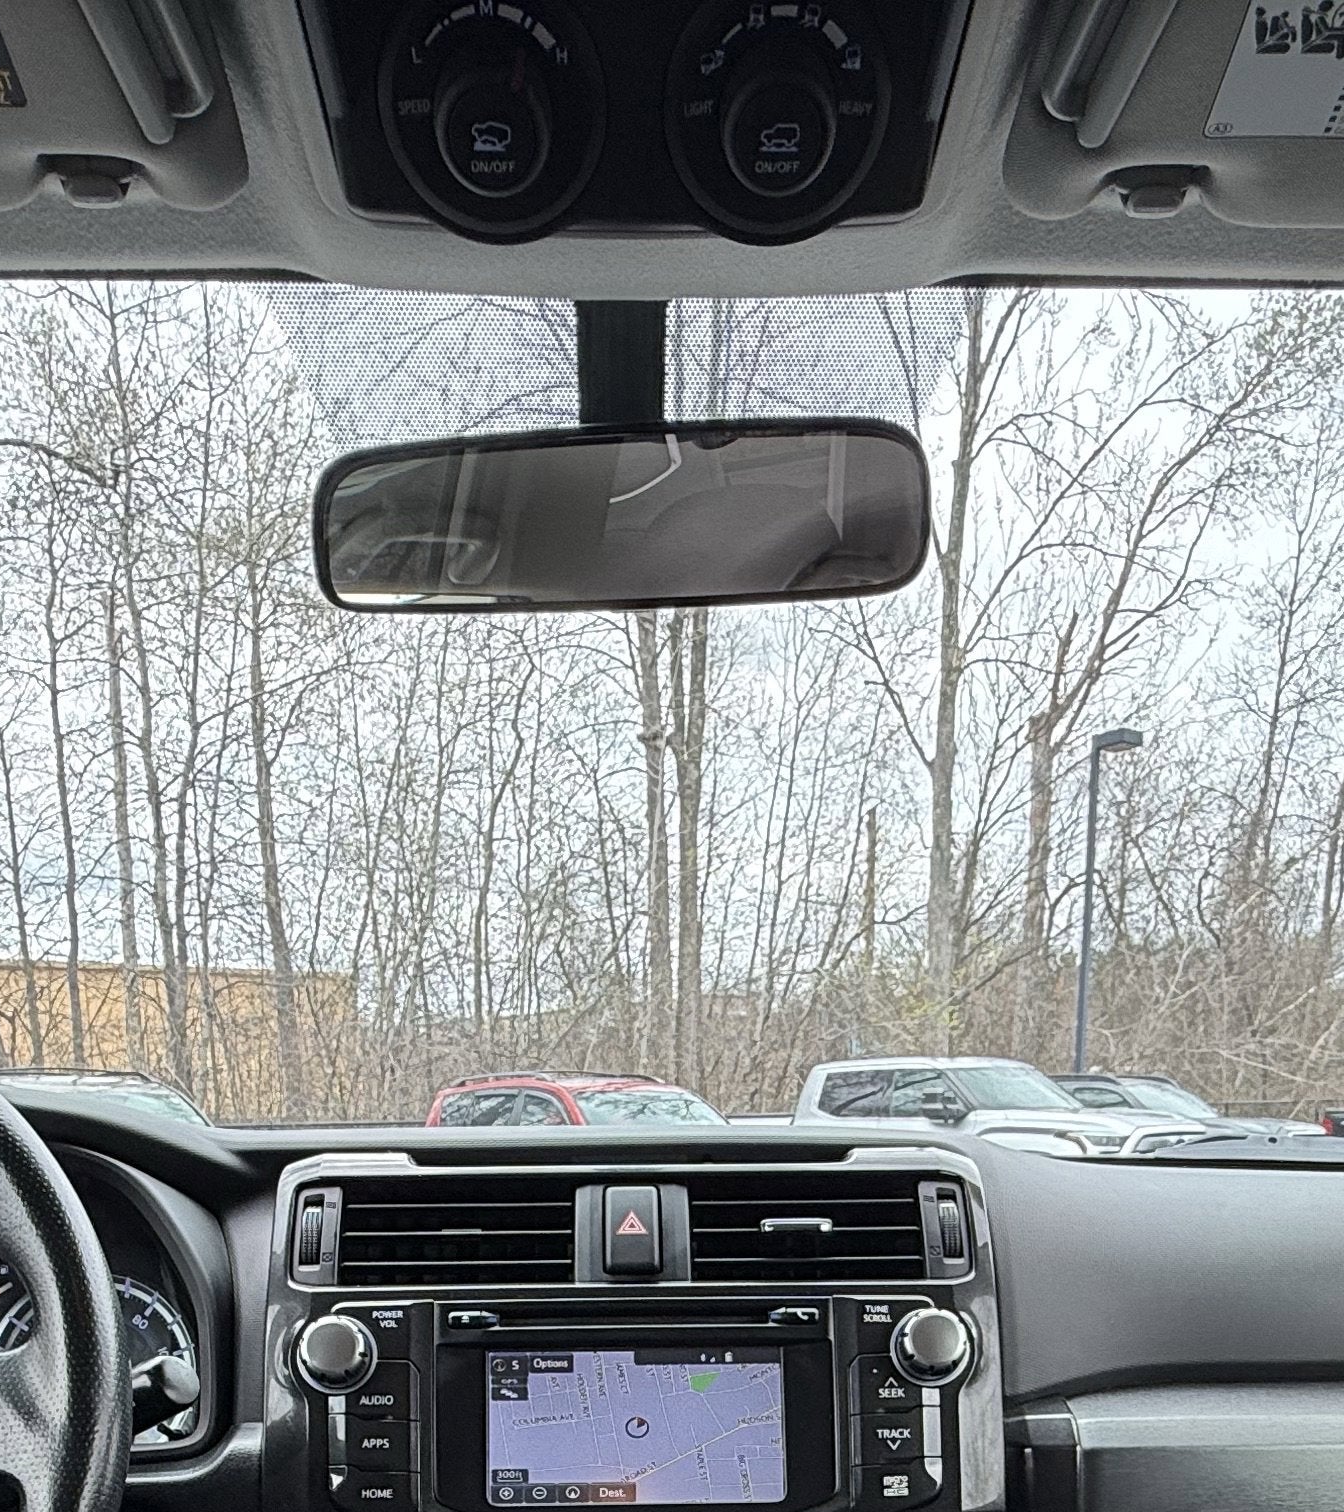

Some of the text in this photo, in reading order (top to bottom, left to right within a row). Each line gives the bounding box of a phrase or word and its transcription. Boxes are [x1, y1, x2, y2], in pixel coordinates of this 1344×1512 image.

[479, 0, 494, 16] M
[411, 47, 422, 64] L
[556, 48, 568, 64] H
[471, 161, 515, 174] ON/OFF
[754, 161, 801, 174] ON/OFF
[864, 1304, 889, 1313] TUNE
[372, 1310, 404, 1319] POWER
[863, 1313, 893, 1323] SCROLL
[131, 1314, 149, 1331] 80
[379, 1319, 398, 1328] VOL
[512, 1358, 569, 1371] S Options
[878, 1388, 906, 1399] SEEK
[359, 1395, 394, 1406] AUDIO
[876, 1428, 911, 1439] TRACK
[362, 1438, 390, 1449] APPS
[361, 1488, 394, 1499] HOME
[599, 1487, 627, 1498] Dest.
